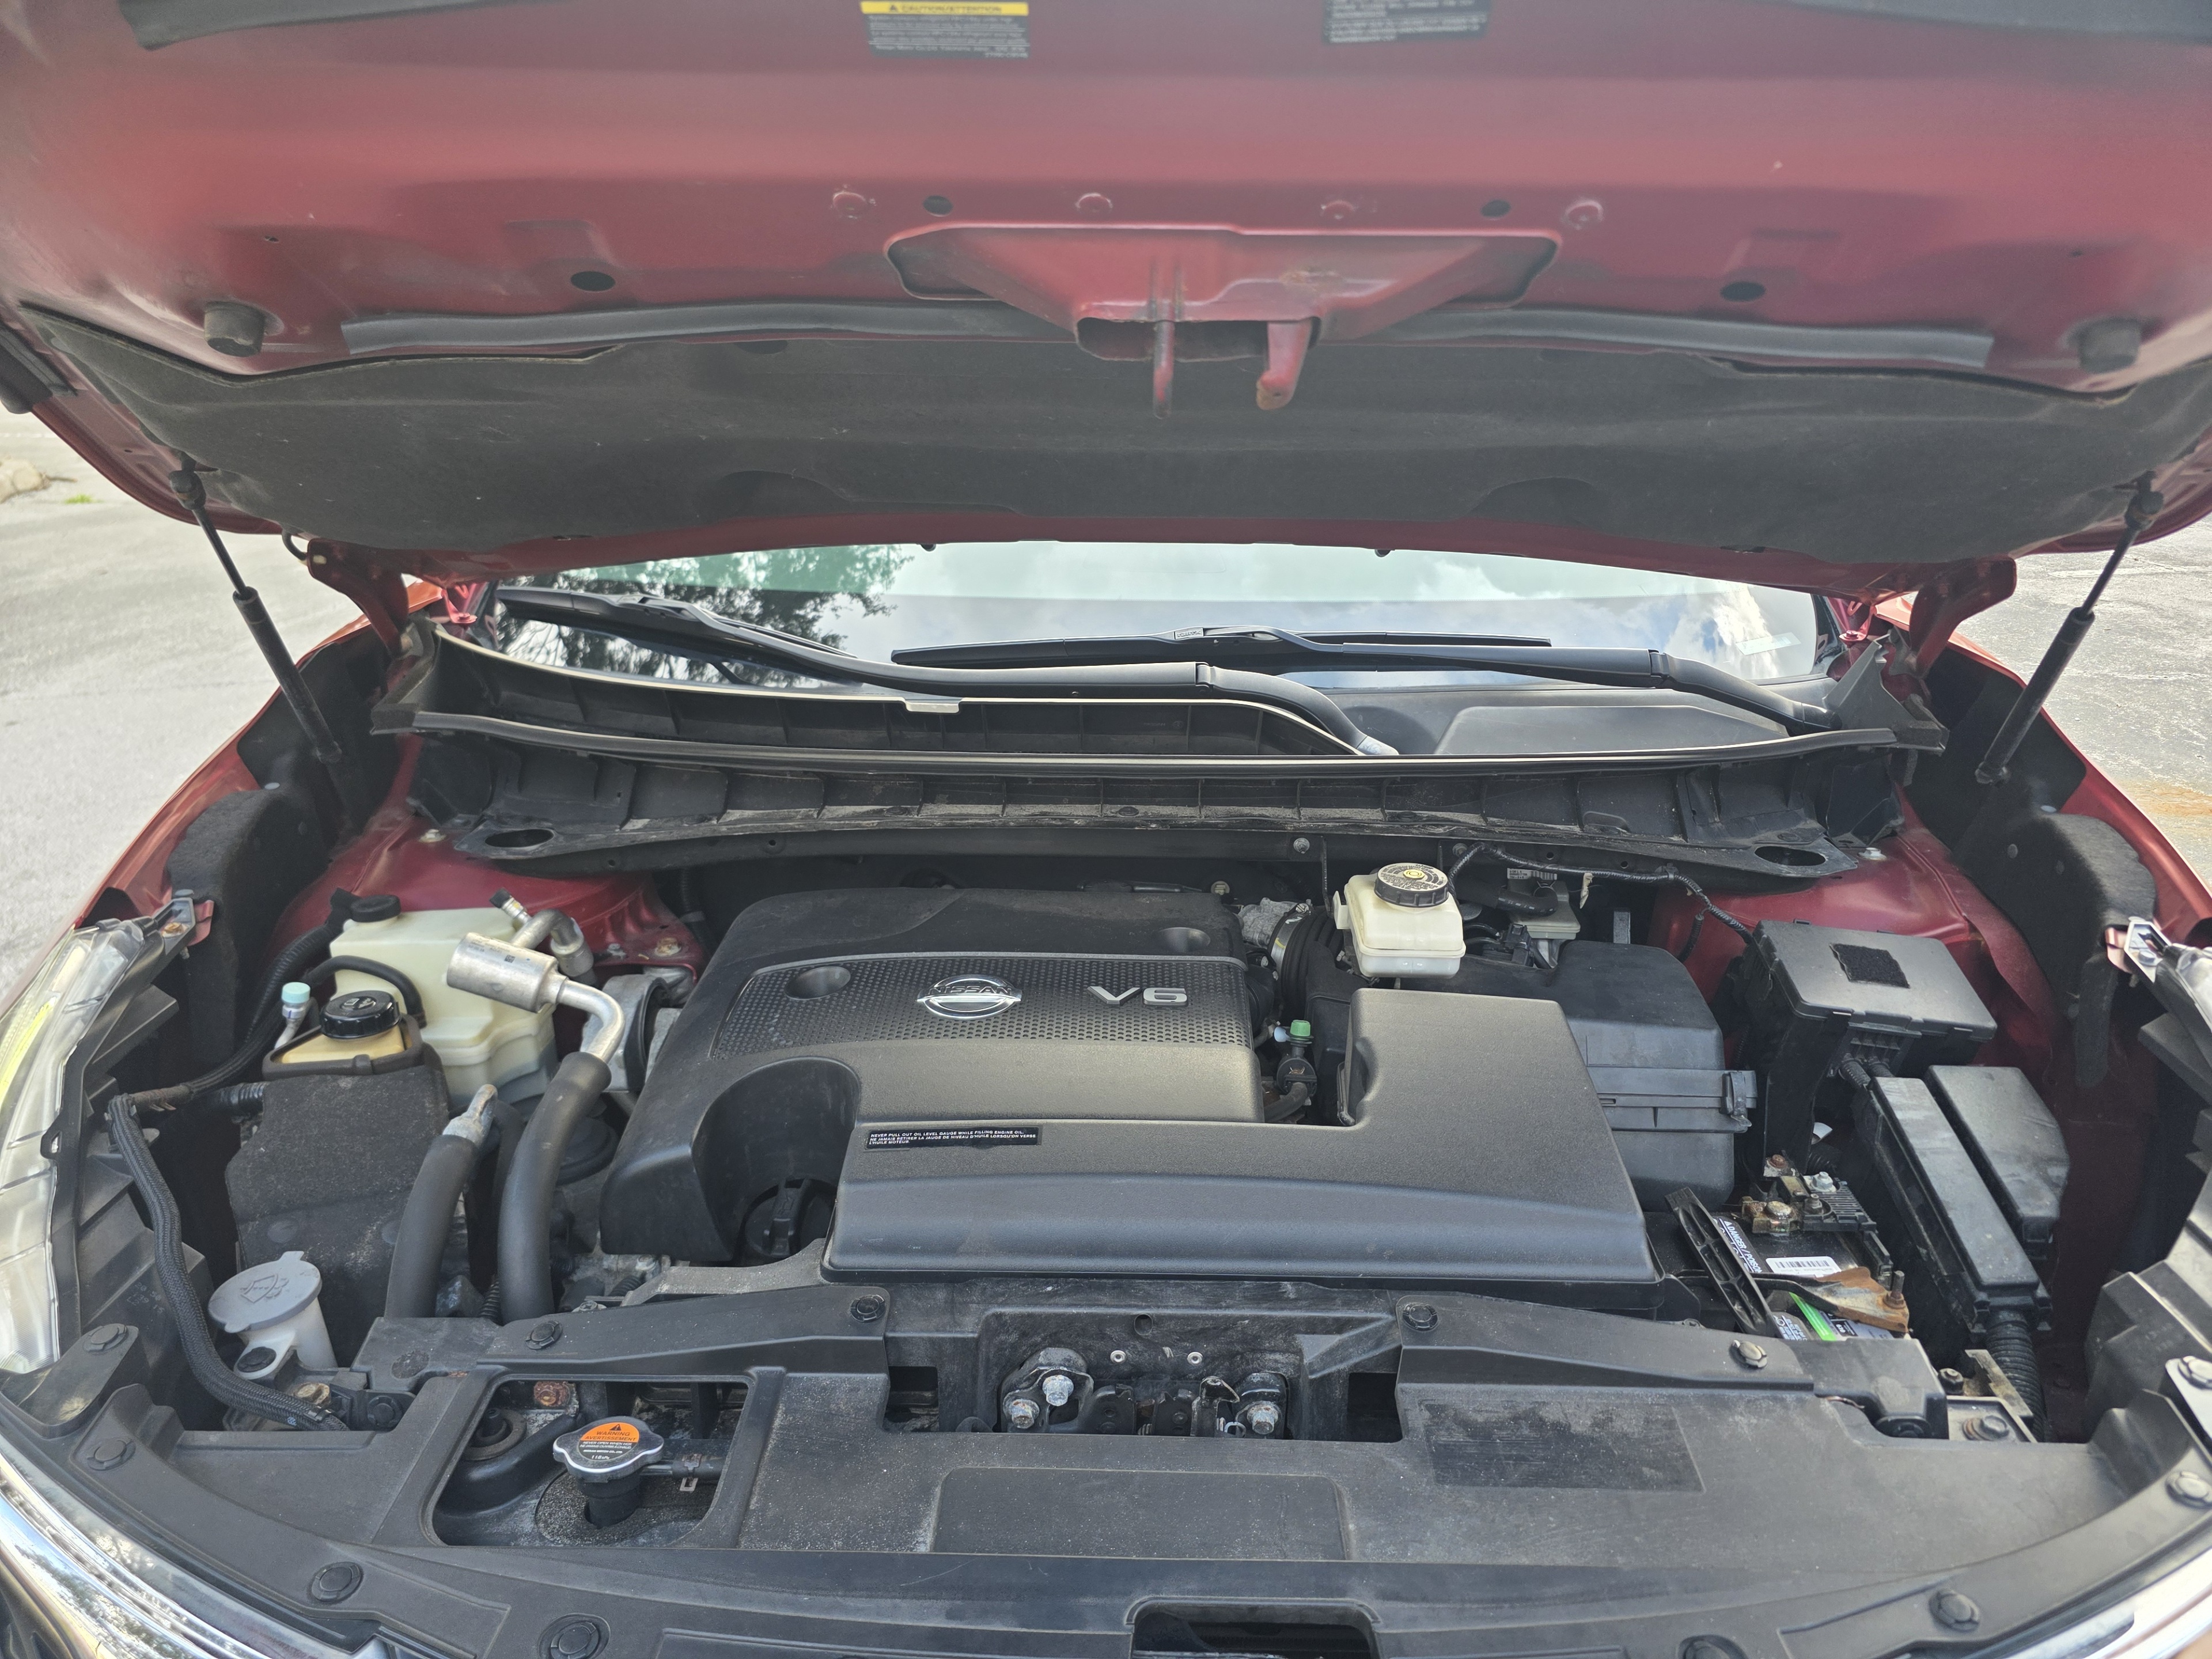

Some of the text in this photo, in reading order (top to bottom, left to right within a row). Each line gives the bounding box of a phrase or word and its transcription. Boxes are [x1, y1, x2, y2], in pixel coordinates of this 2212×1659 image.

[929, 986, 1012, 996] NISSAN
[1087, 986, 1188, 1006] V6
[1727, 1226, 1747, 1249] DANGER
